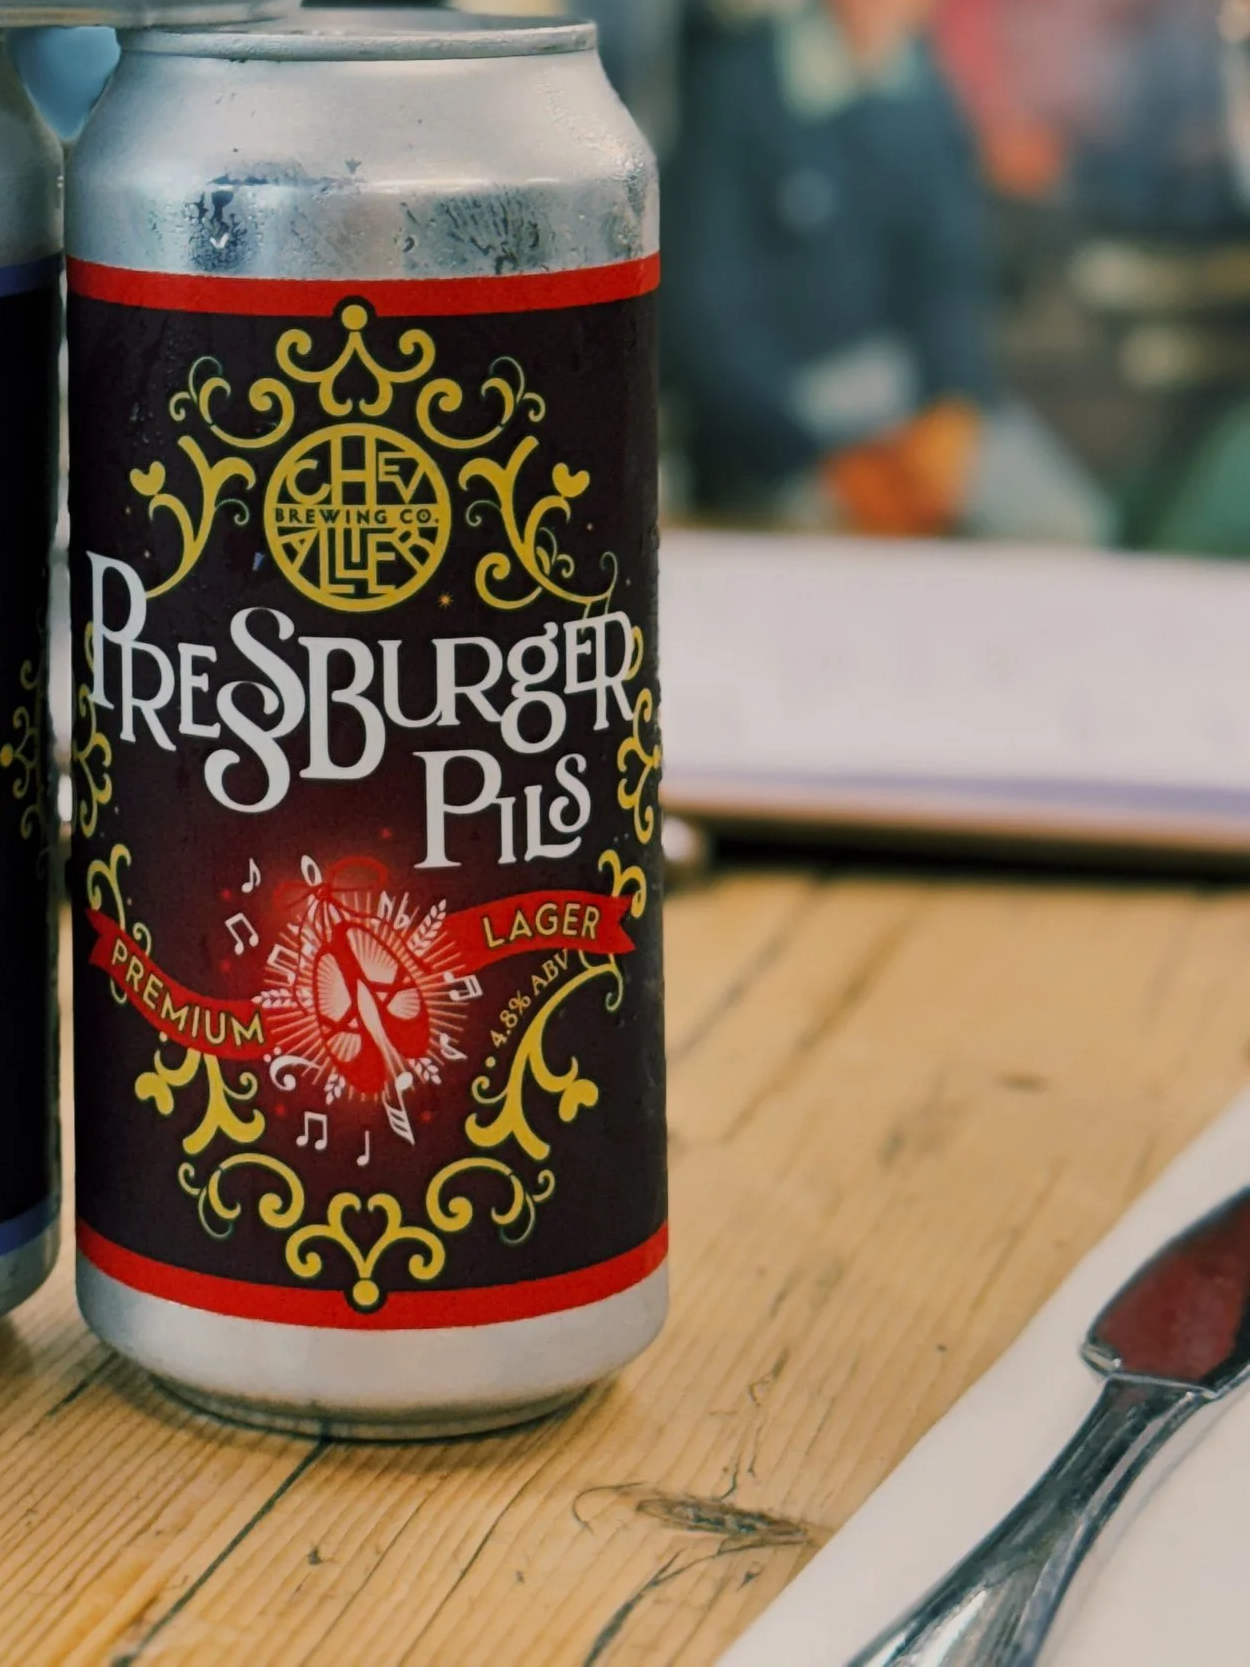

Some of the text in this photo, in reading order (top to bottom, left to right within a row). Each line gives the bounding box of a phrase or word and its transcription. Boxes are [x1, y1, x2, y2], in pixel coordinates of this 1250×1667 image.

[275, 508, 440, 525] BREWING CO.
[412, 748, 592, 869] PILS
[482, 903, 600, 948] LAGER
[111, 937, 265, 1047] PREMIUM
[490, 946, 569, 1049] 4.8% ABV
